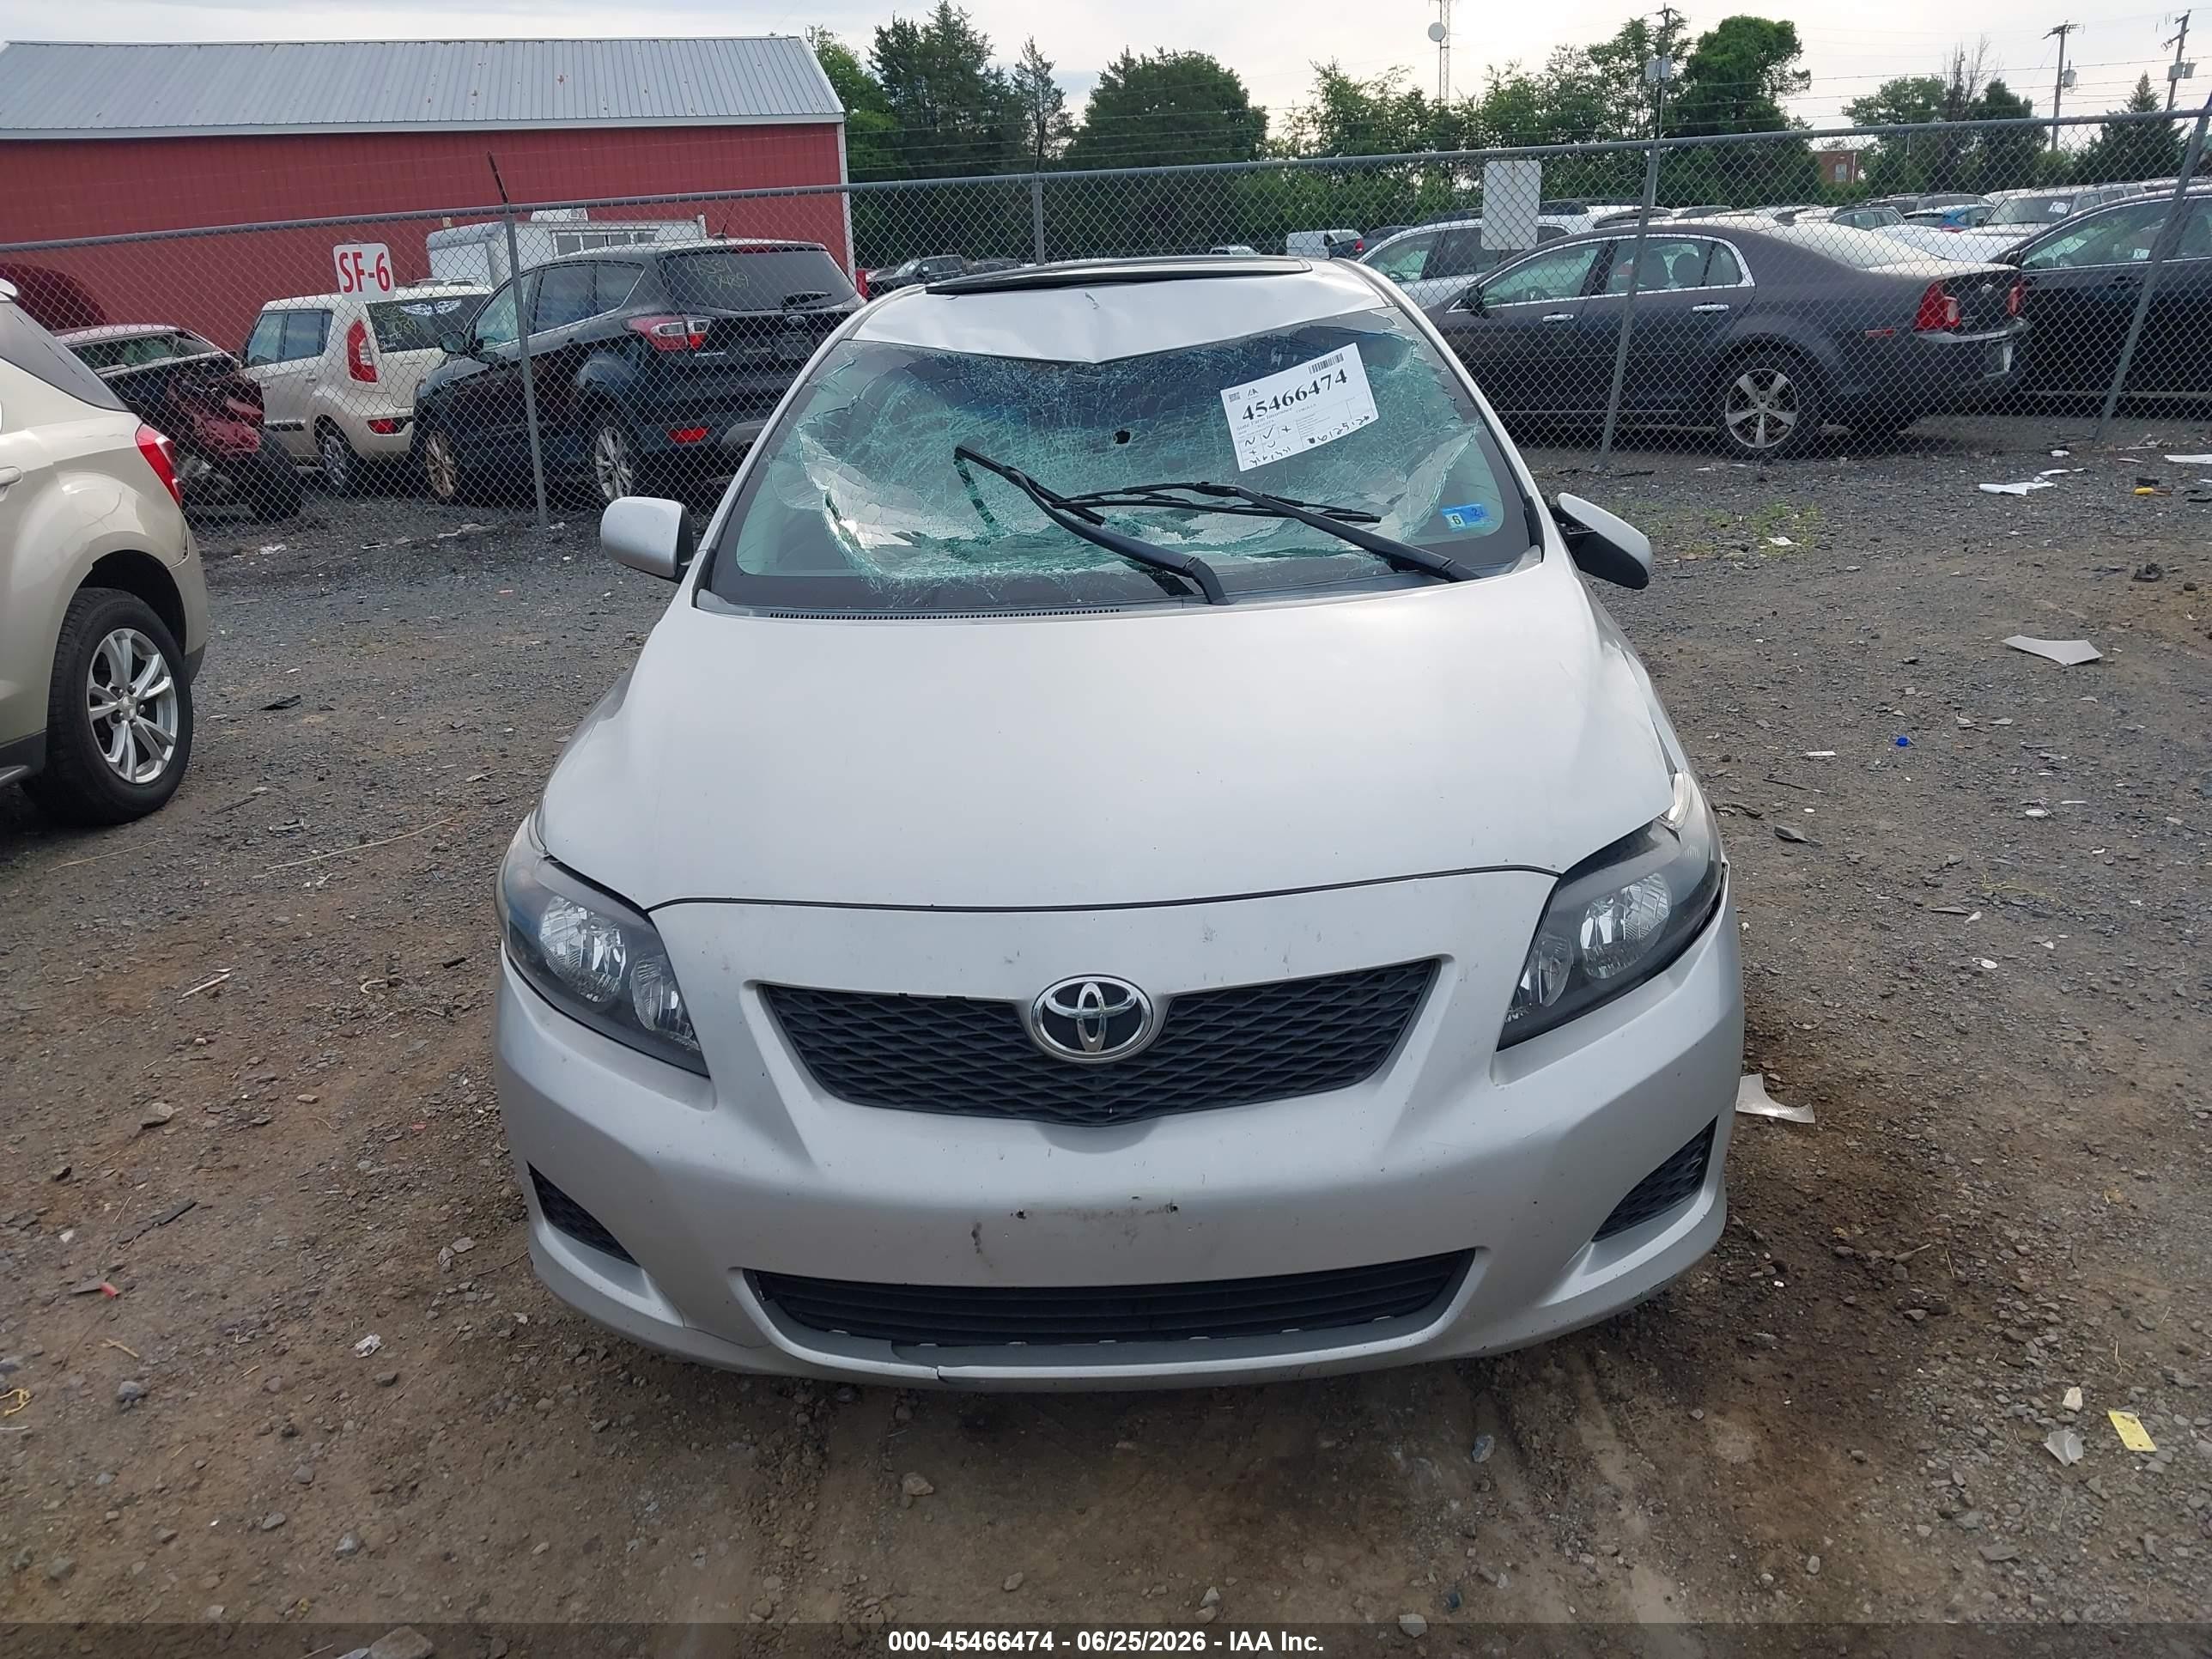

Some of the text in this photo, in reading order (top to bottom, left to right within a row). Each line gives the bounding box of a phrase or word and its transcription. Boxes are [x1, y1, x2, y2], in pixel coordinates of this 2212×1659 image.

[339, 252, 391, 293] SF-6
[1243, 369, 1347, 420] 45466474
[1452, 515, 1462, 525] 6
